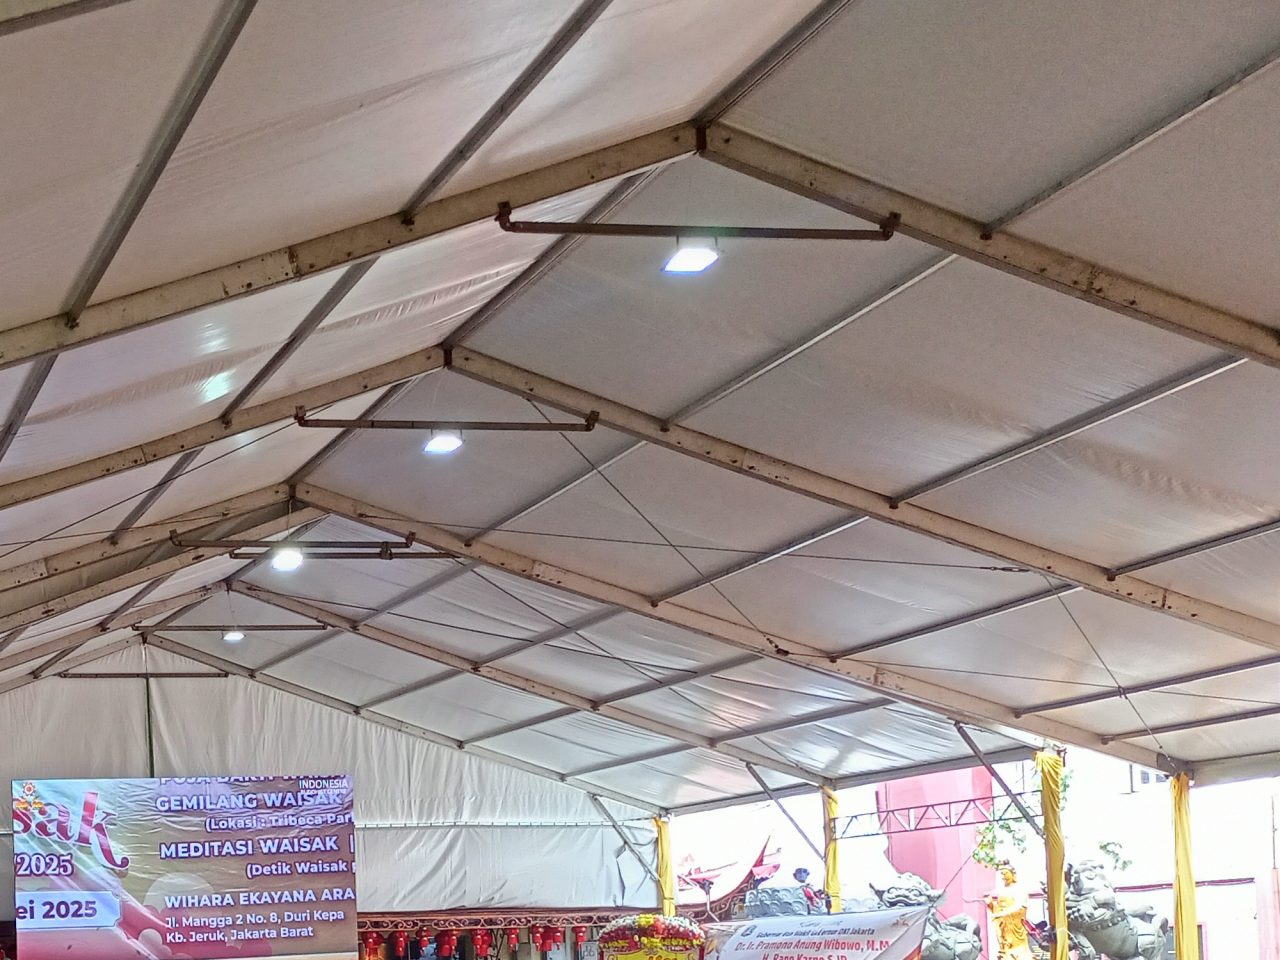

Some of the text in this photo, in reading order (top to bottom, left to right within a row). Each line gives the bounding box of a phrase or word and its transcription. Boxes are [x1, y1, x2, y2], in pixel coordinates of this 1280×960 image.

[299, 779, 349, 789] INDONESIA
[156, 790, 343, 812] GEMILANG WAISAK
[269, 815, 322, 828] Tribeca
[160, 835, 339, 859] MEDITASI WAISAK
[14, 853, 73, 877] 2025
[246, 860, 348, 879] (Detik Waisak
[164, 893, 234, 909] WIHARA
[239, 889, 317, 905] EKAYANA
[41, 900, 98, 919] 2025
[182, 915, 233, 929] Mangga
[235, 914, 244, 925] 2
[246, 913, 267, 924] No.
[270, 912, 282, 925] 8,
[284, 910, 311, 922] Duri
[313, 909, 345, 923] Kepa
[166, 926, 314, 944] Kb. Jeruk, Jakarta Barat
[850, 928, 876, 936] Jakarta
[735, 942, 746, 951] Dr.
[755, 940, 793, 951] Pramono
[793, 939, 824, 952] Anung
[823, 939, 864, 953] Wibowo,
